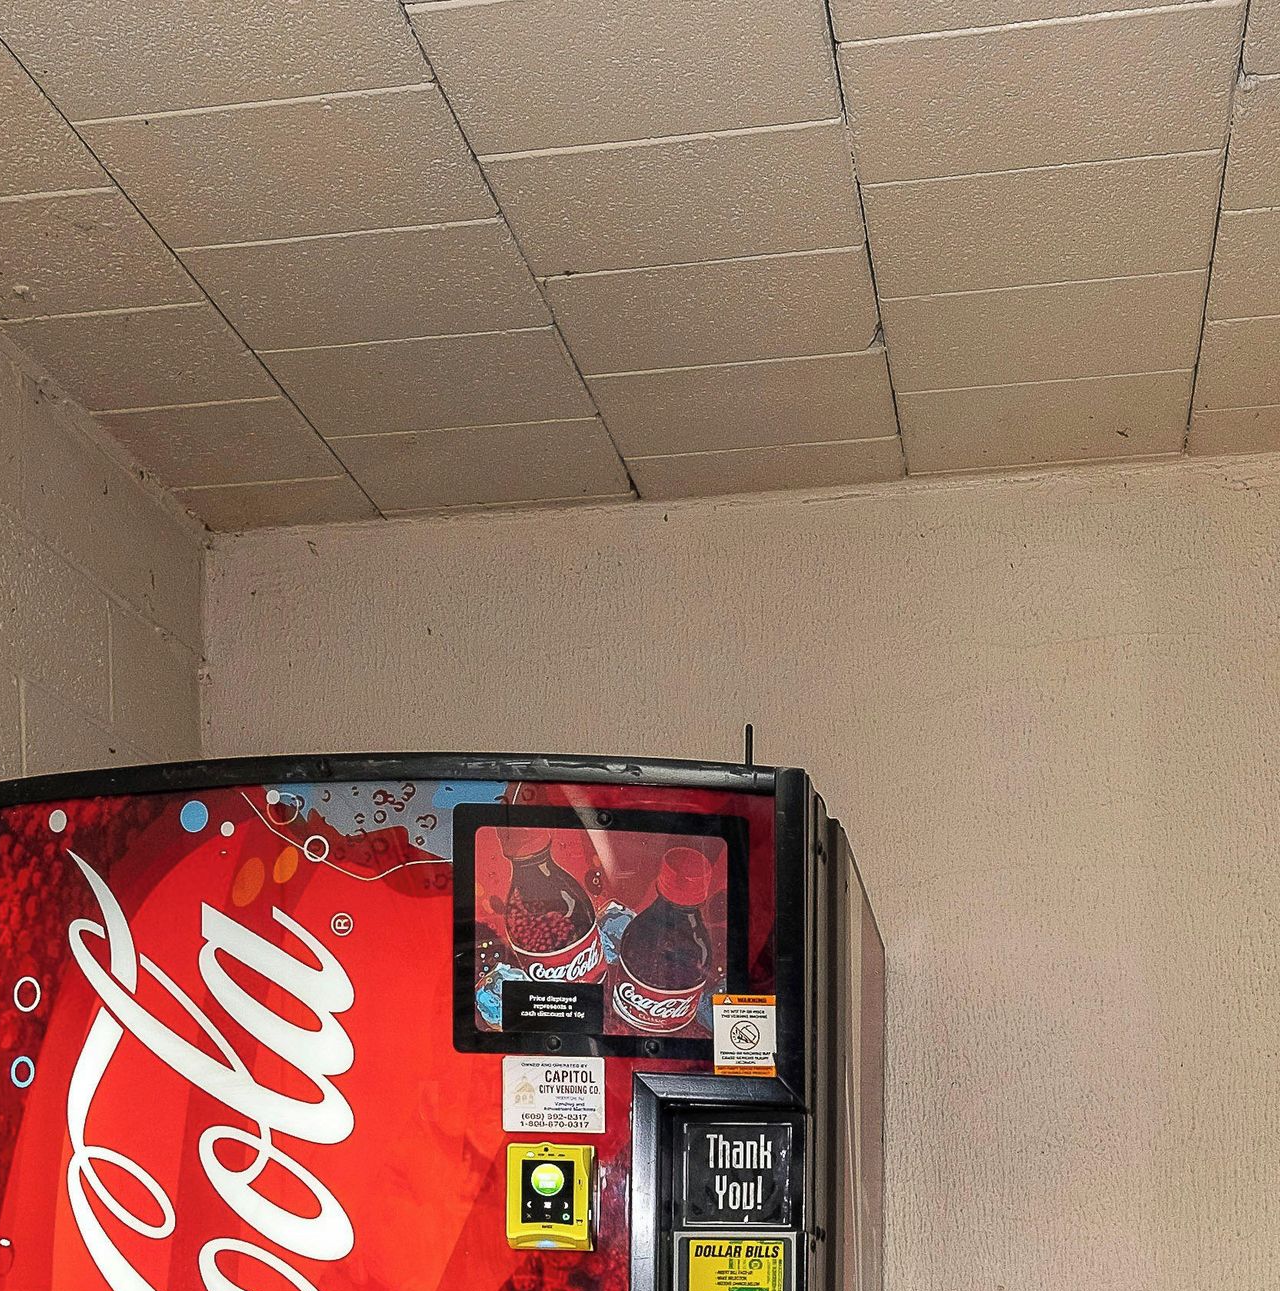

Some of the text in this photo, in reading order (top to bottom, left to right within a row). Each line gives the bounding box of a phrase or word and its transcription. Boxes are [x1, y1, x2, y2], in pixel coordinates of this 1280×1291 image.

[546, 995, 577, 1004] displayed
[545, 1070, 596, 1083] CAPITOL
[539, 1084, 600, 1094] CITY VENDING CO.
[706, 1134, 772, 1169] Thank
[715, 1175, 763, 1210] You!
[695, 1245, 780, 1258] DOLLAR BILLS
